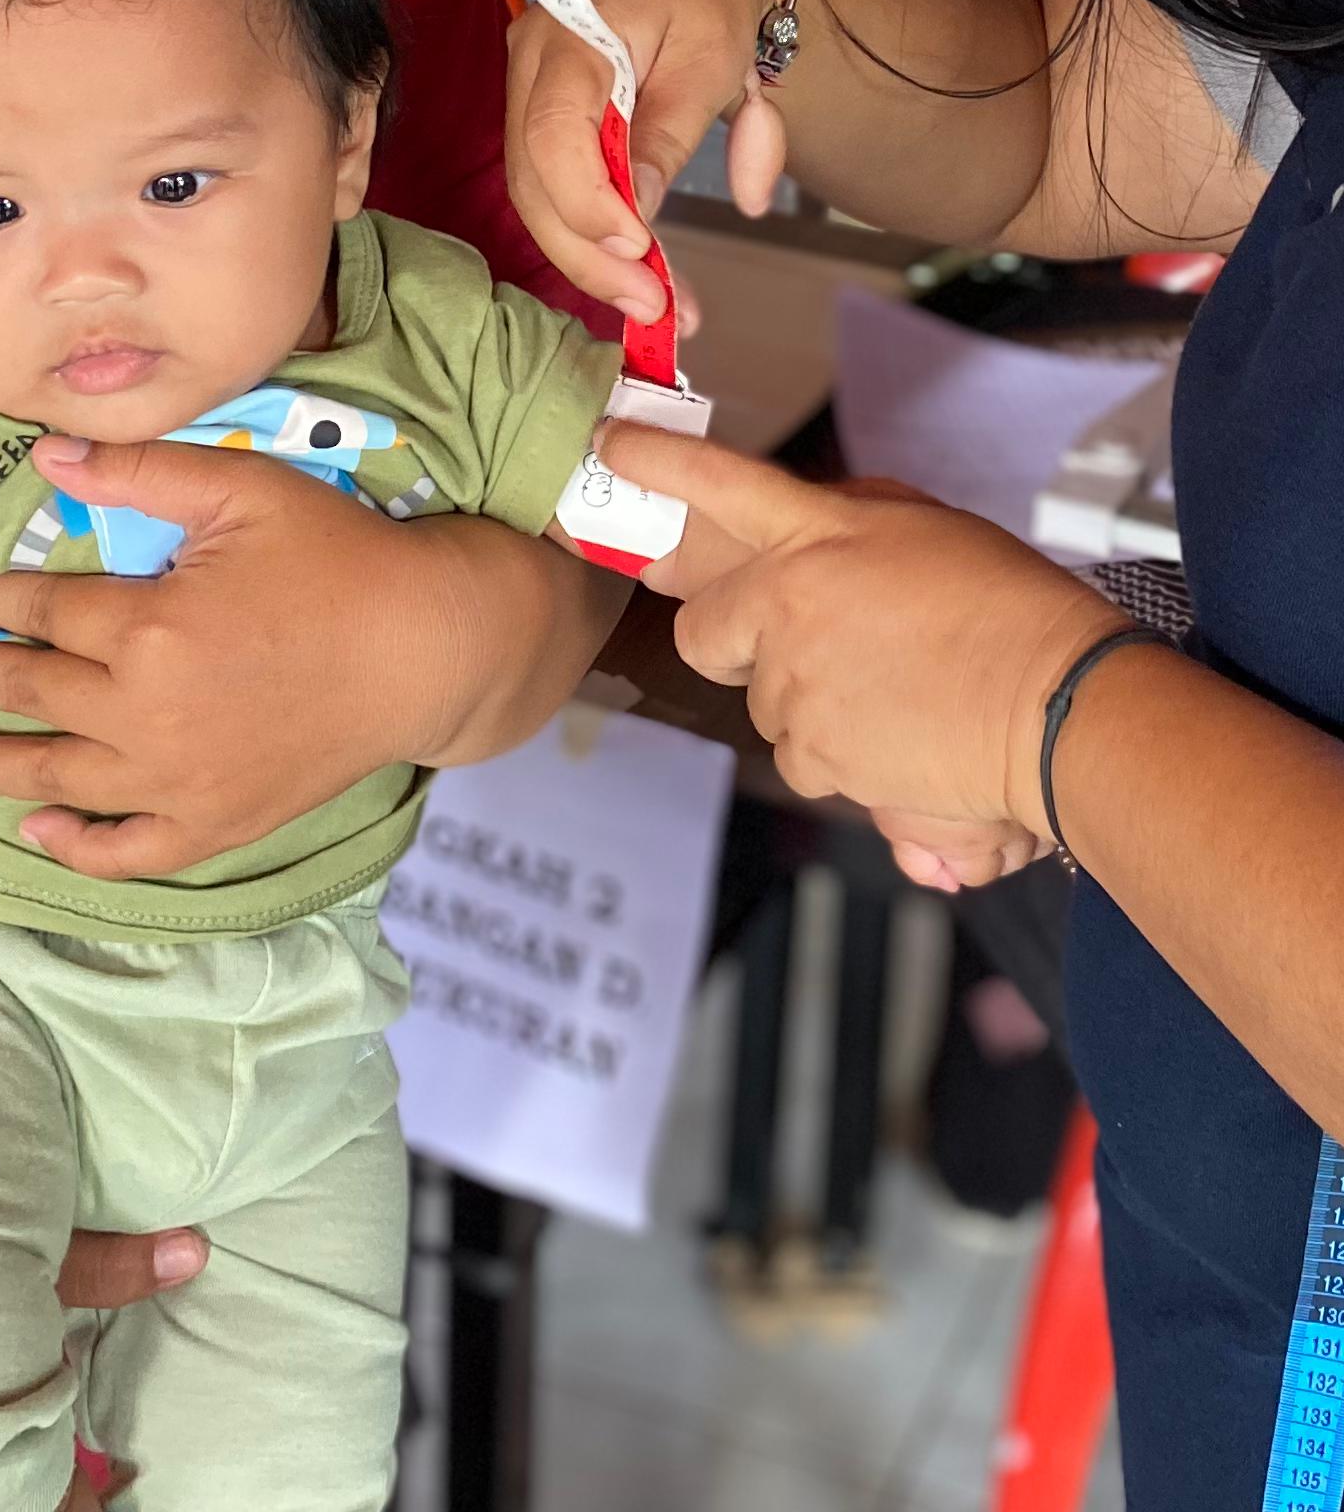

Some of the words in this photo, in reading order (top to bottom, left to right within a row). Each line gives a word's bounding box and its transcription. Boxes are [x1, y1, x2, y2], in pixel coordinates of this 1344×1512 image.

[585, 872, 627, 927] 2
[1312, 1338, 1342, 1359] 131
[1306, 1372, 1337, 1394] 132
[1301, 1406, 1332, 1427] 133
[1296, 1437, 1326, 1459] 134
[1291, 1468, 1321, 1489] 135
